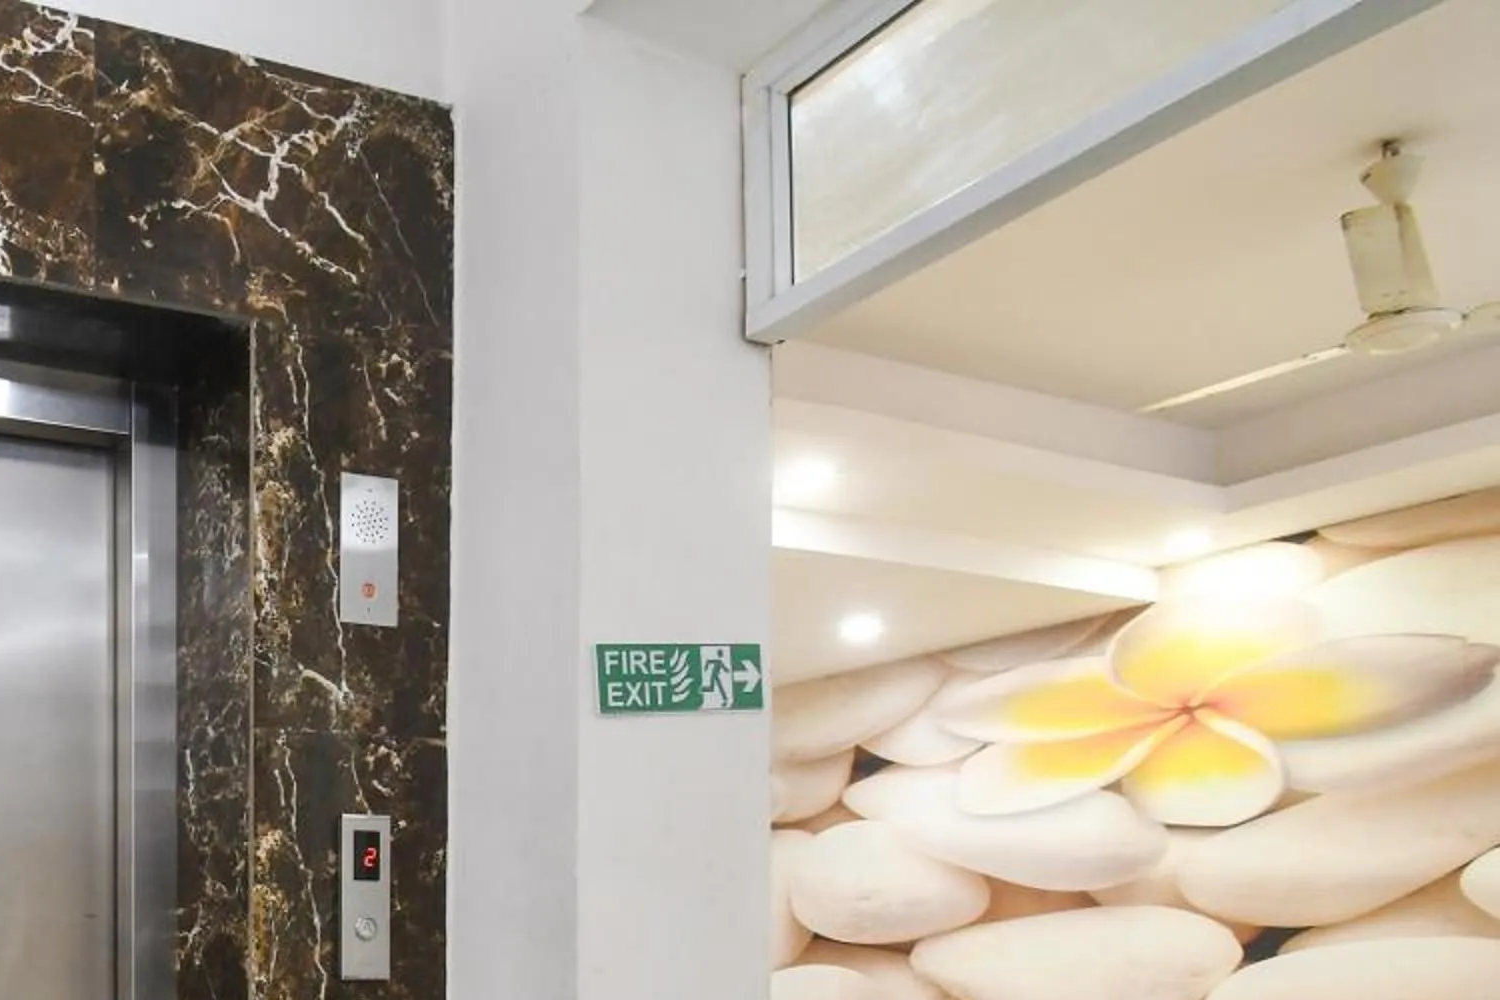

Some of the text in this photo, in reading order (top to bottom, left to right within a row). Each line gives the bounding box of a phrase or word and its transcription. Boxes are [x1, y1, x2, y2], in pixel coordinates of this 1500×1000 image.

[604, 650, 667, 675] FIRE
[607, 681, 668, 707] EXIT
[363, 847, 378, 867] 2
